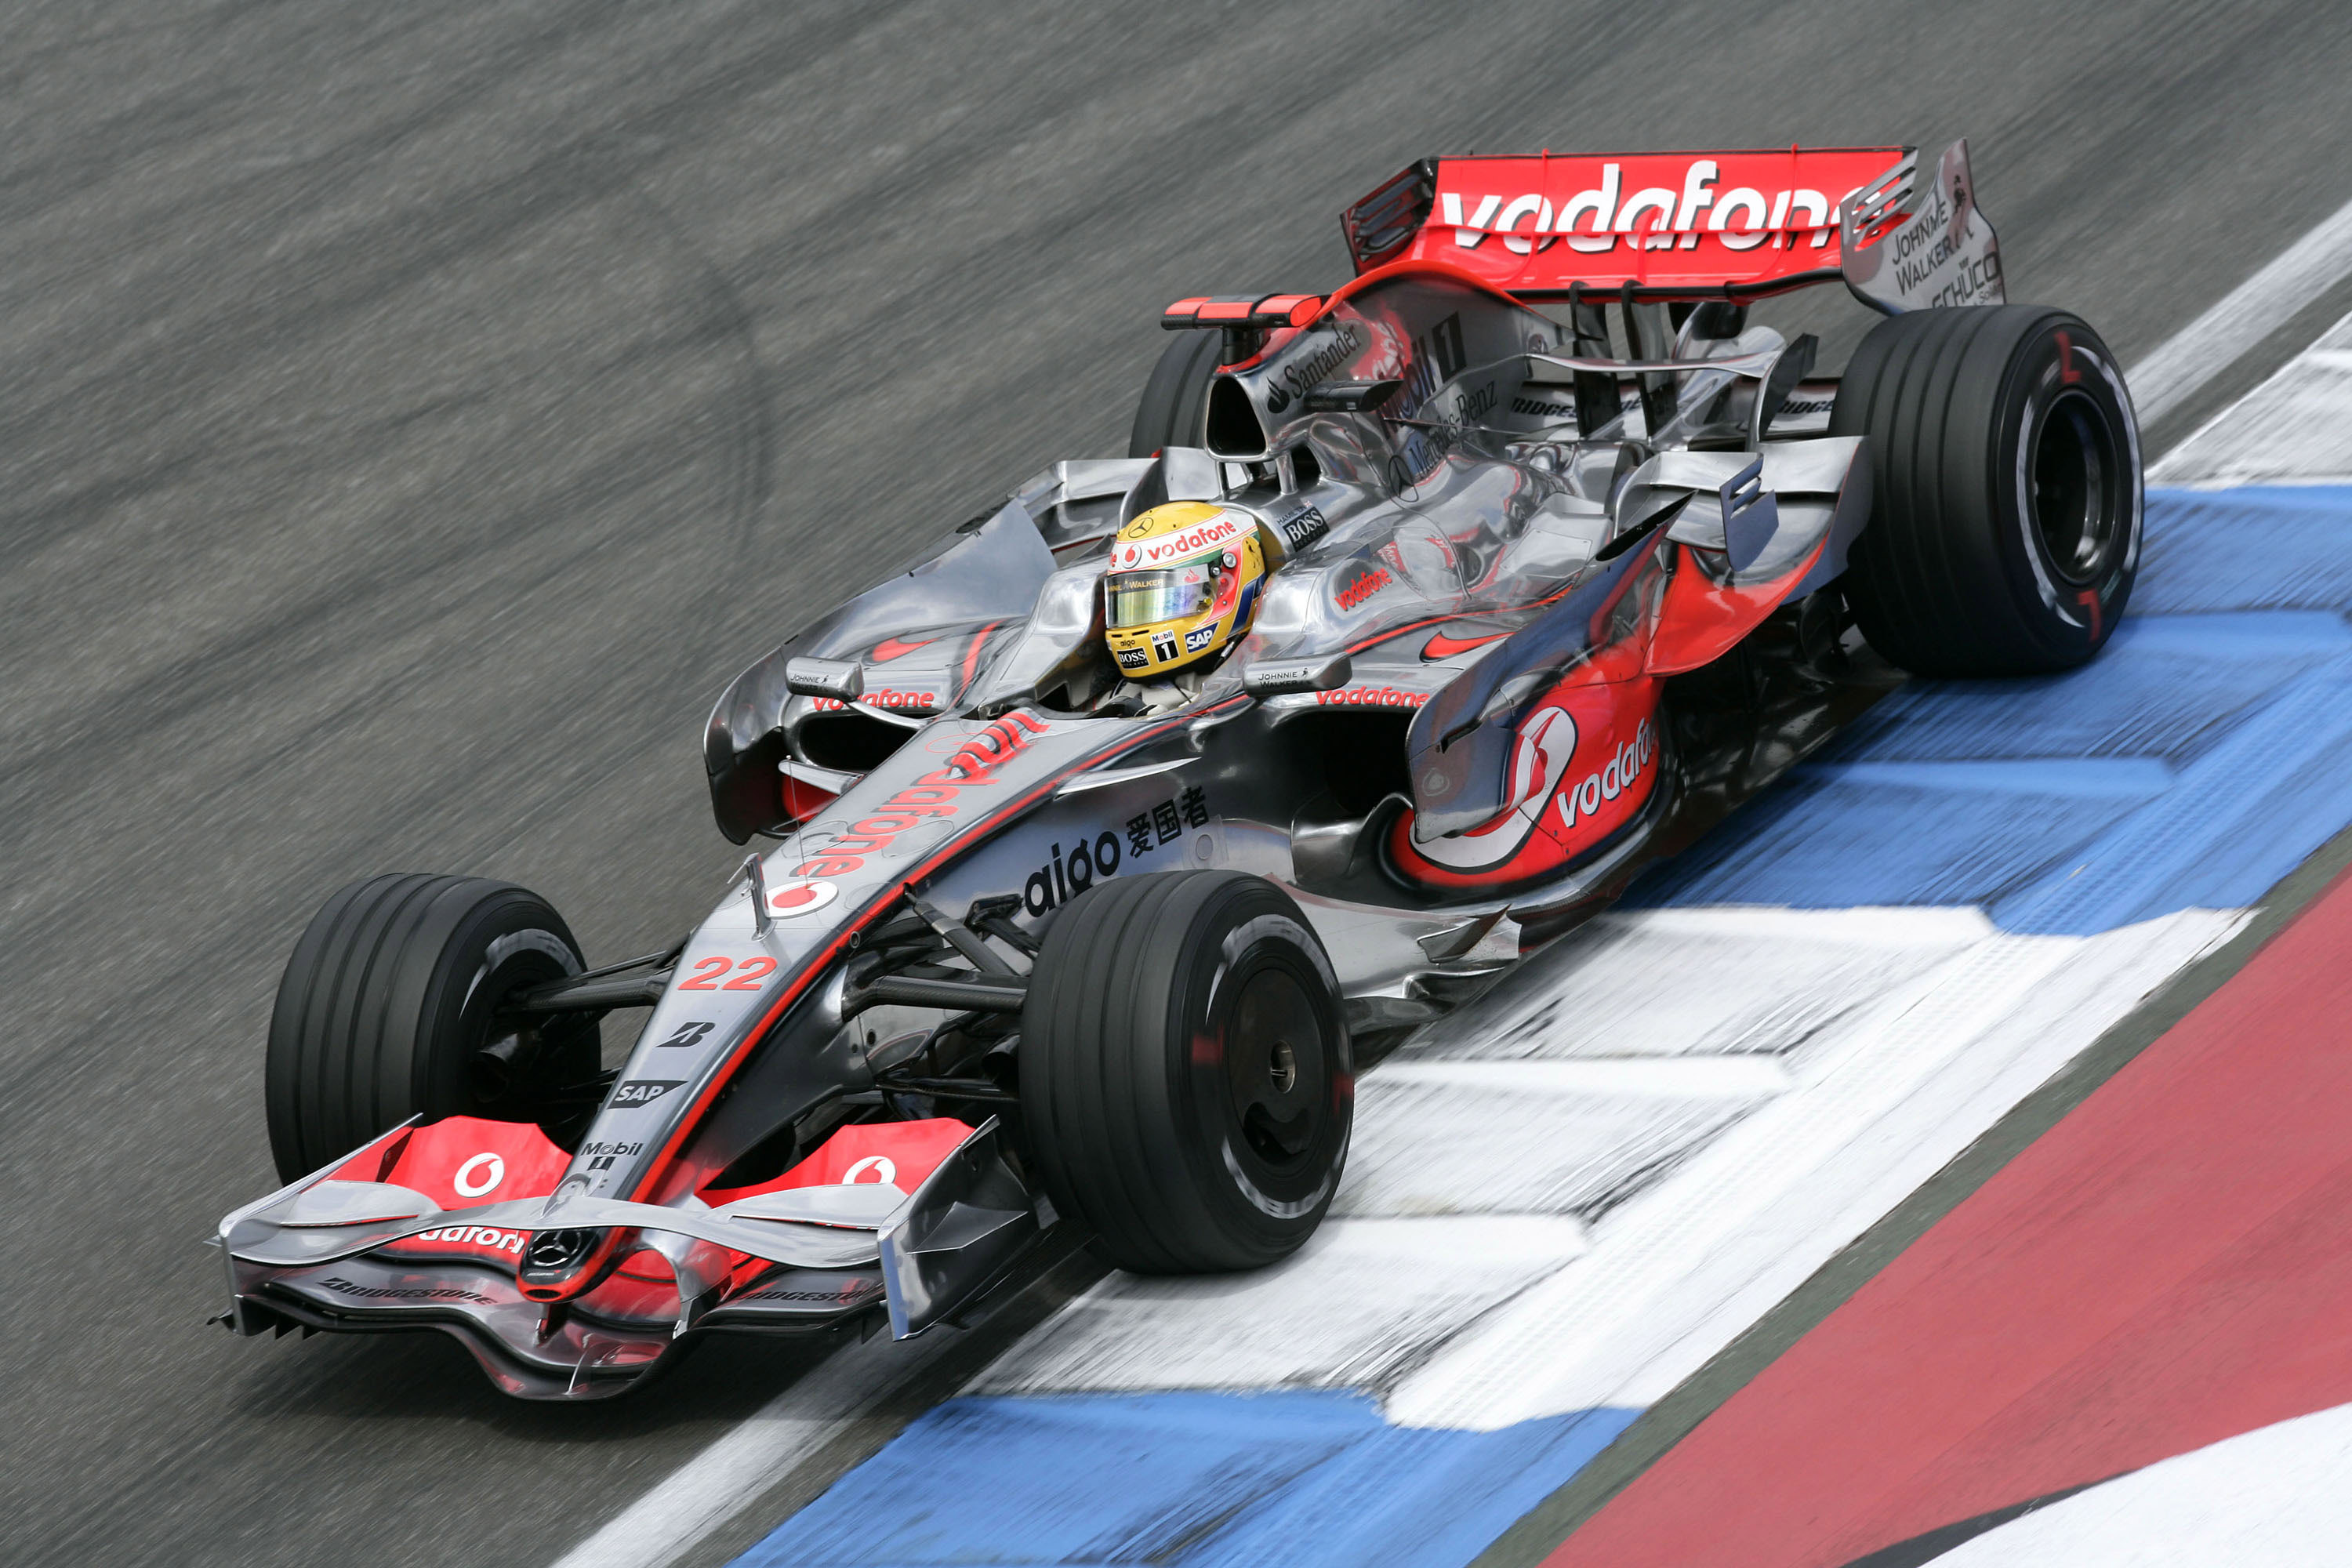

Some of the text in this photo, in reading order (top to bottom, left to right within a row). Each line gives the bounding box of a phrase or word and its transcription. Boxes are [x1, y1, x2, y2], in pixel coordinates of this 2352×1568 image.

[1896, 234, 1954, 296] WALKER
[1283, 321, 1361, 400] Santander
[1436, 315, 1464, 380] 1
[1408, 379, 1497, 480] Mercedes-Benz
[1147, 521, 1236, 561] vodafone
[1286, 510, 1323, 543] BOSS
[1334, 567, 1393, 611] vodafone
[1152, 631, 1174, 643] Mobil
[1186, 630, 1213, 650] SAP
[1118, 651, 1146, 663] BOSS
[789, 673, 821, 684] JOHNNIE
[1258, 671, 1298, 681] JOHNNIE
[812, 688, 935, 711] voafone
[1315, 684, 1430, 707] vodafone
[1126, 785, 1210, 859] 爱国者
[1025, 830, 1121, 917] aigo
[677, 956, 778, 991] 22
[615, 1085, 665, 1102] SAP
[580, 1142, 644, 1156] Mobil
